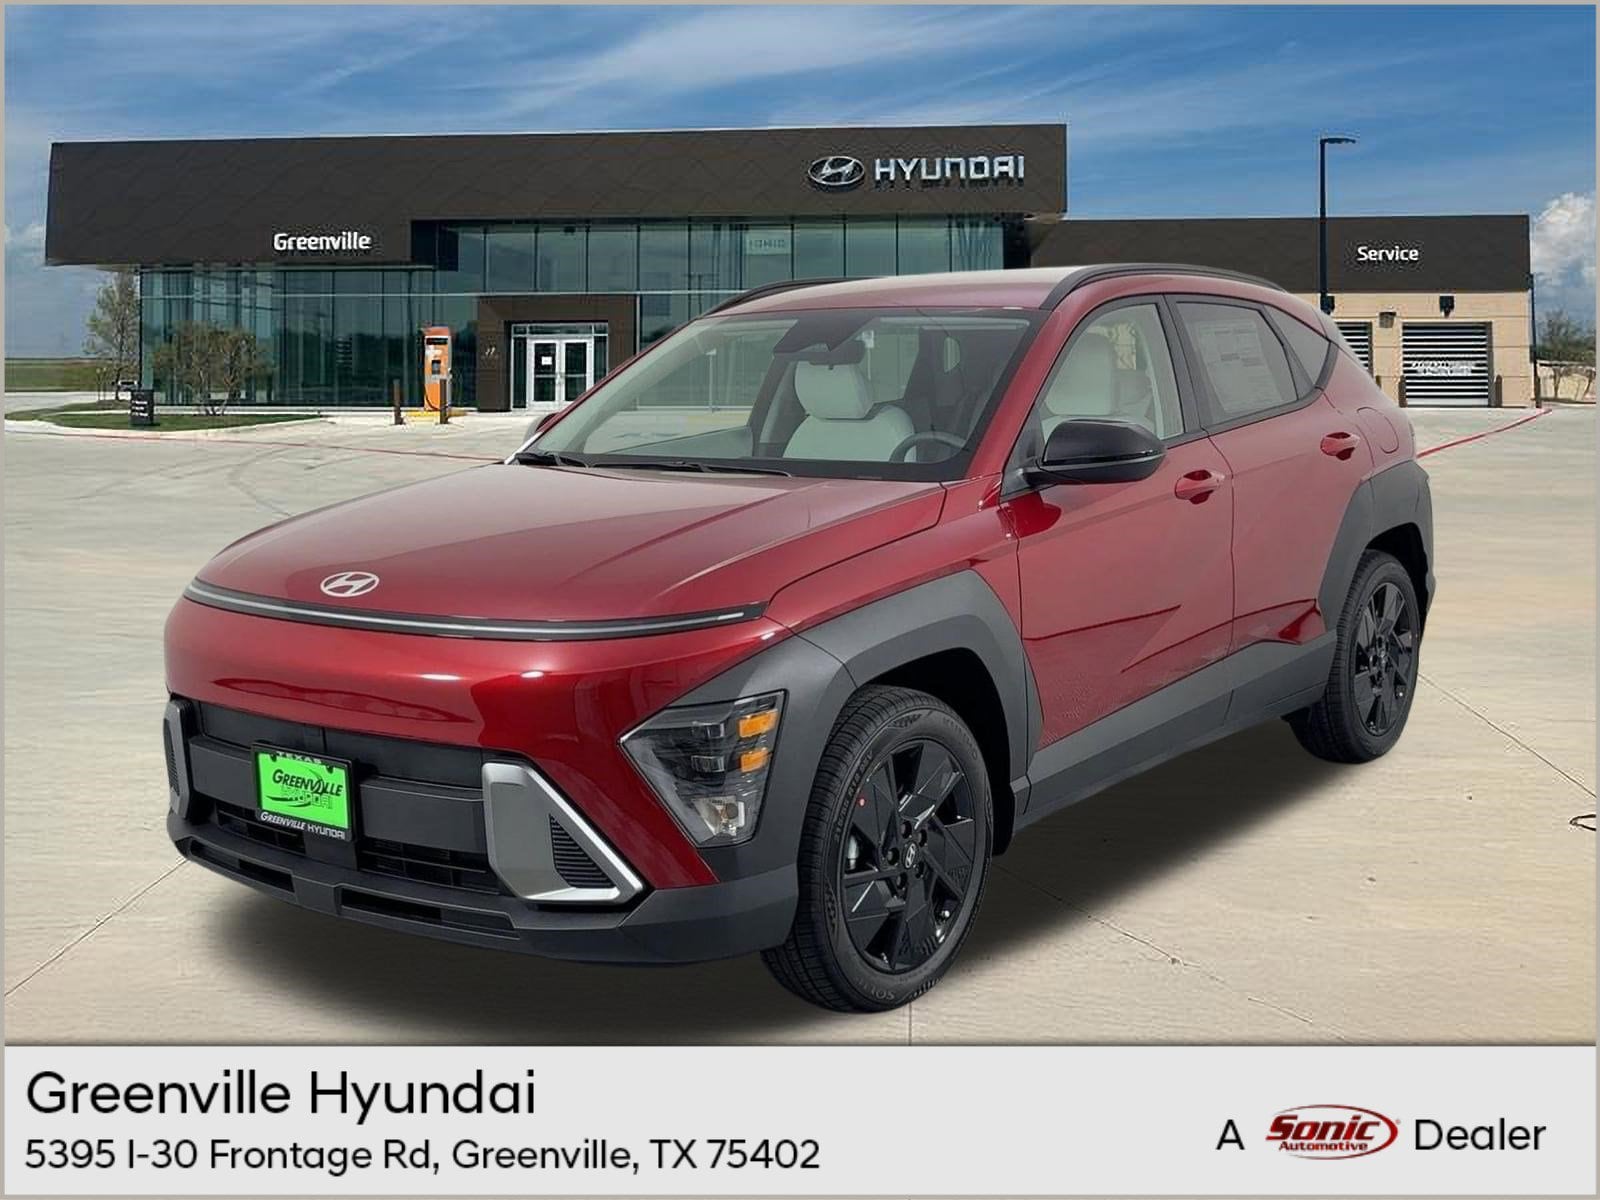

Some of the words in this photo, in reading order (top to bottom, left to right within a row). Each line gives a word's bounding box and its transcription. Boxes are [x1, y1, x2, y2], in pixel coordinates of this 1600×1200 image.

[875, 155, 1025, 181] HYUNDAI
[273, 231, 372, 251] Greenville
[1357, 245, 1419, 261] Service
[307, 823, 346, 840] HYUNDAI
